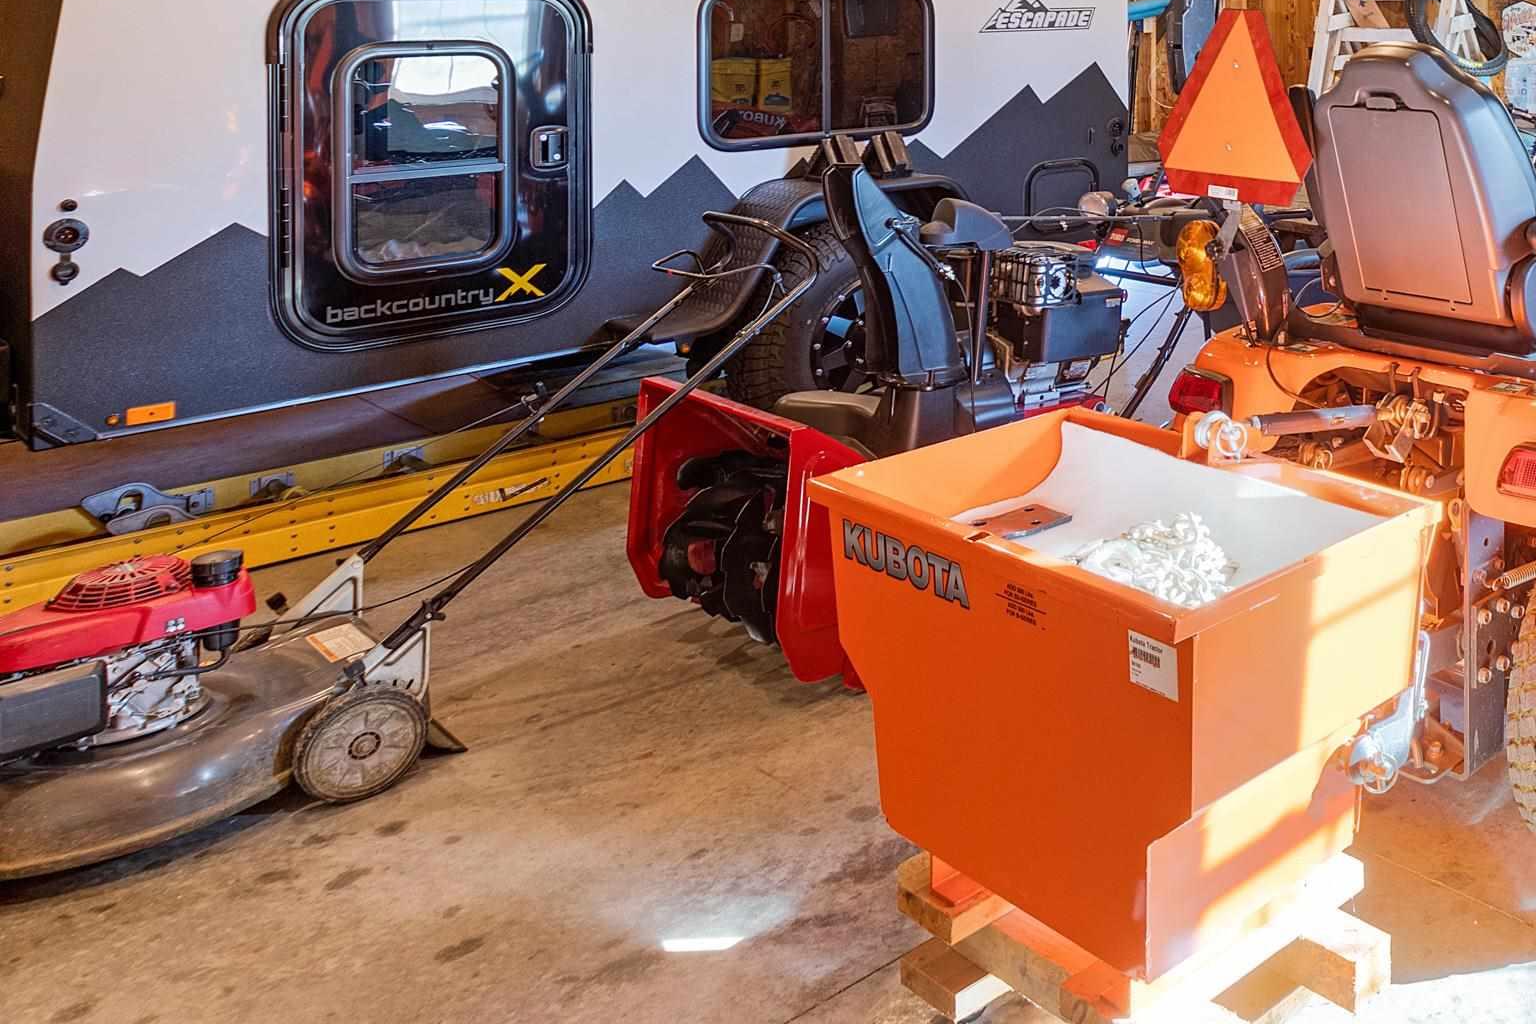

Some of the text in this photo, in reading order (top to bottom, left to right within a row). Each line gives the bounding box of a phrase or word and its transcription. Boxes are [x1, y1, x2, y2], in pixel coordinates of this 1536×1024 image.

[995, 10, 1092, 29] ESCAPADE
[325, 287, 495, 324] backcountry
[842, 518, 971, 610] KUBOTA
